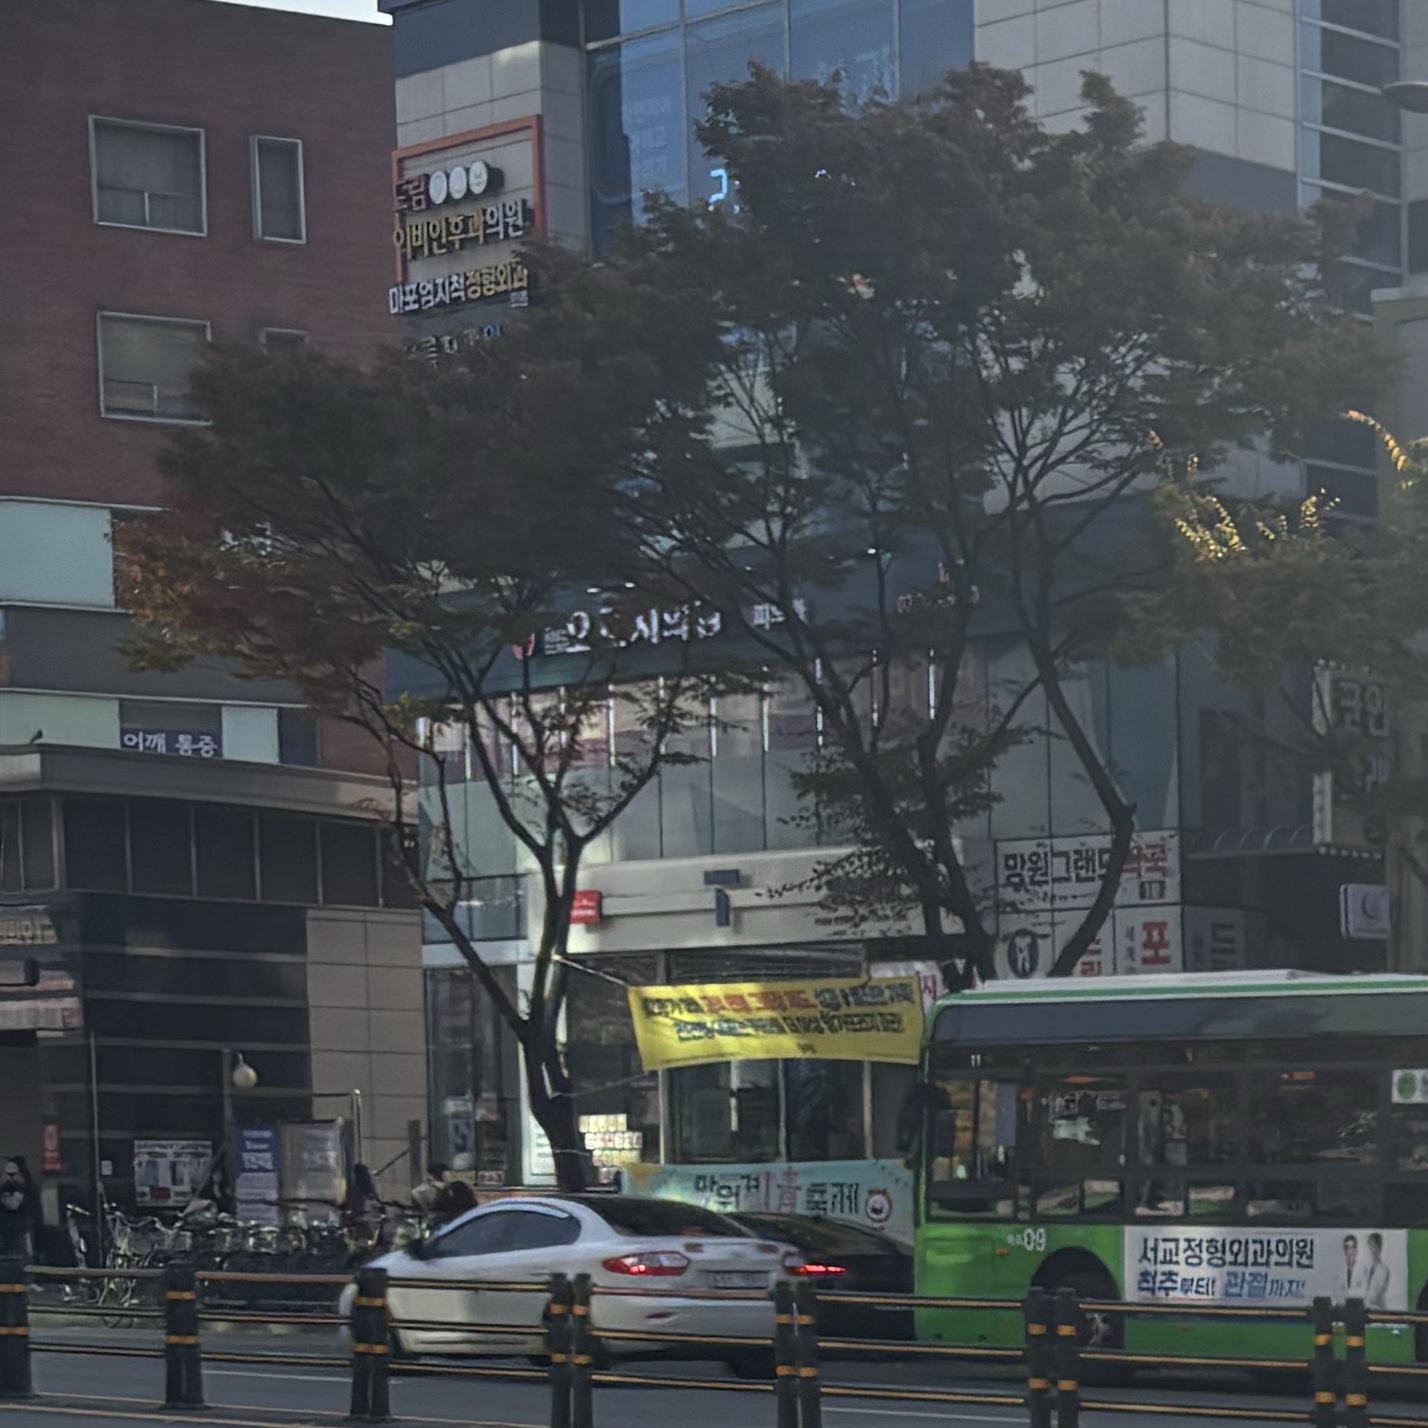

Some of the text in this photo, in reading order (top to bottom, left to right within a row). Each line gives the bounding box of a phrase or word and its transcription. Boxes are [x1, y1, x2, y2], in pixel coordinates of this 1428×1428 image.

[393, 199, 523, 260] 이비인후과의원
[123, 731, 219, 758] 어깨 통증
[1138, 1237, 1315, 1270] 서교정형외과의원
